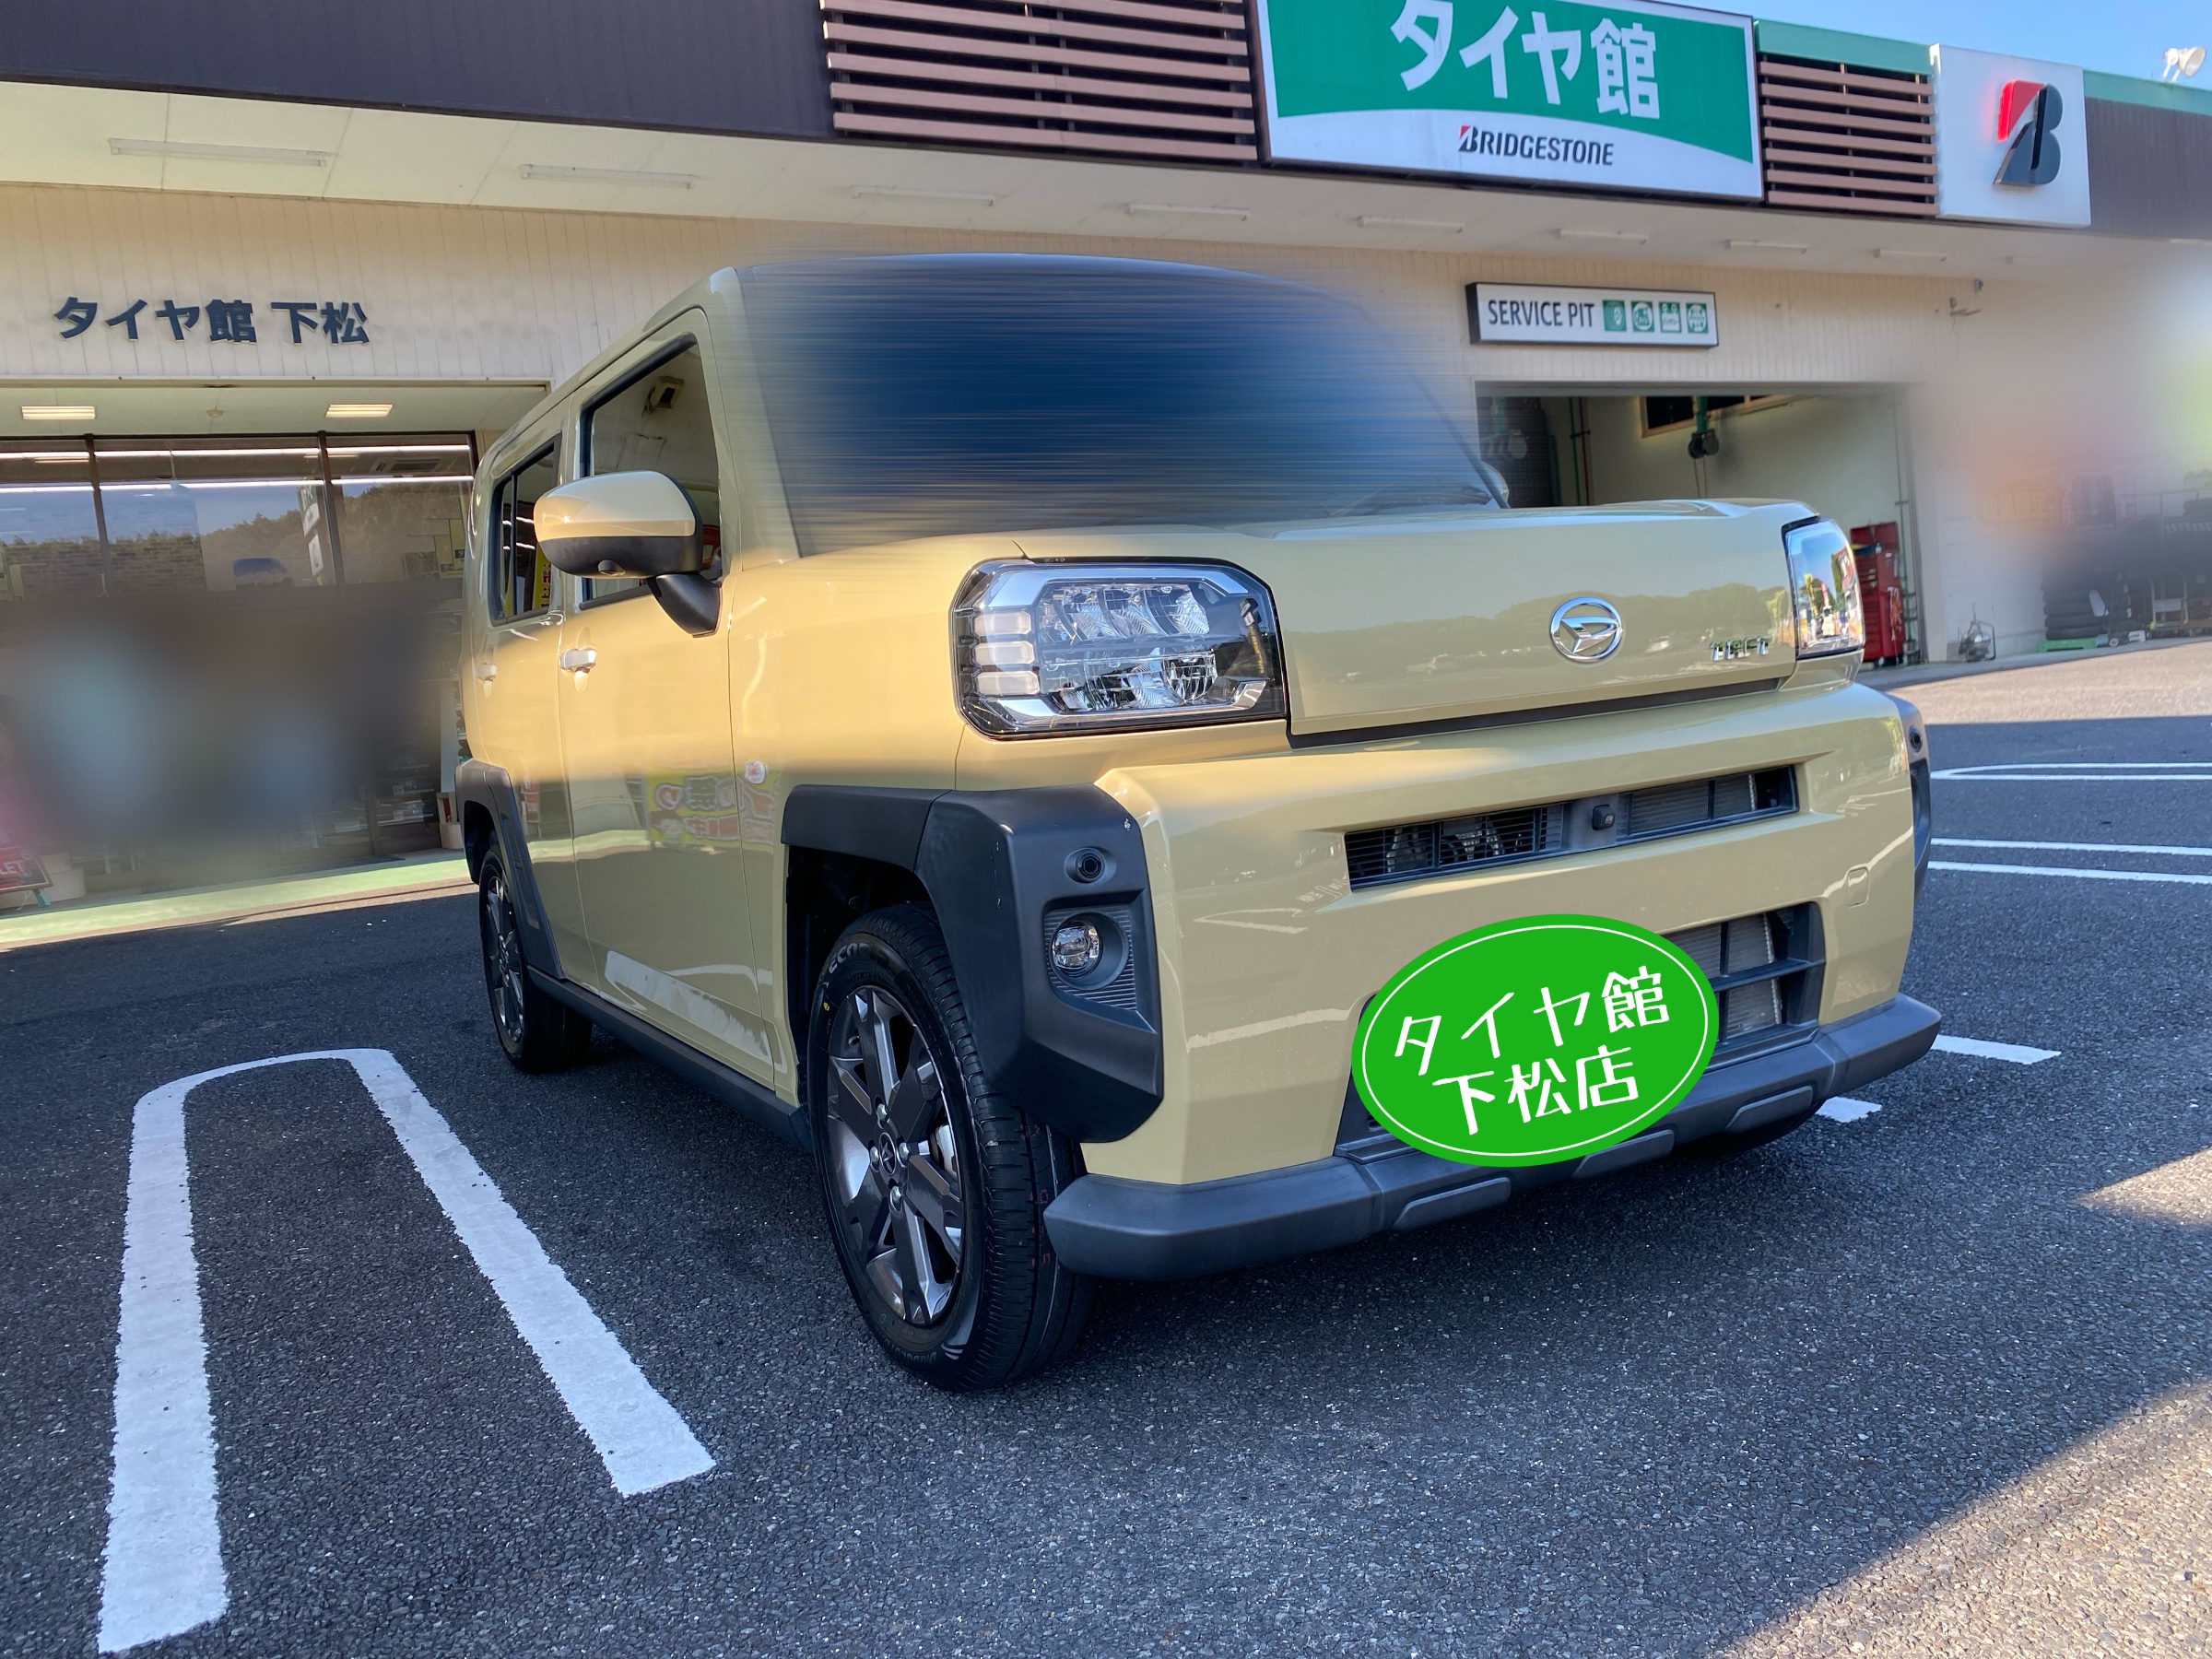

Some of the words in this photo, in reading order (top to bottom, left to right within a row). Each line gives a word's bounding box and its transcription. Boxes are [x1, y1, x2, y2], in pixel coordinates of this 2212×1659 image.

[1390, 0, 1661, 120] タイヤ館
[1457, 124, 1615, 167] BRIDGESTONE
[53, 296, 258, 344] タイヤ館
[270, 300, 371, 346] 下松
[1488, 299, 1563, 327] SERVICE
[1568, 301, 1595, 327] PIT
